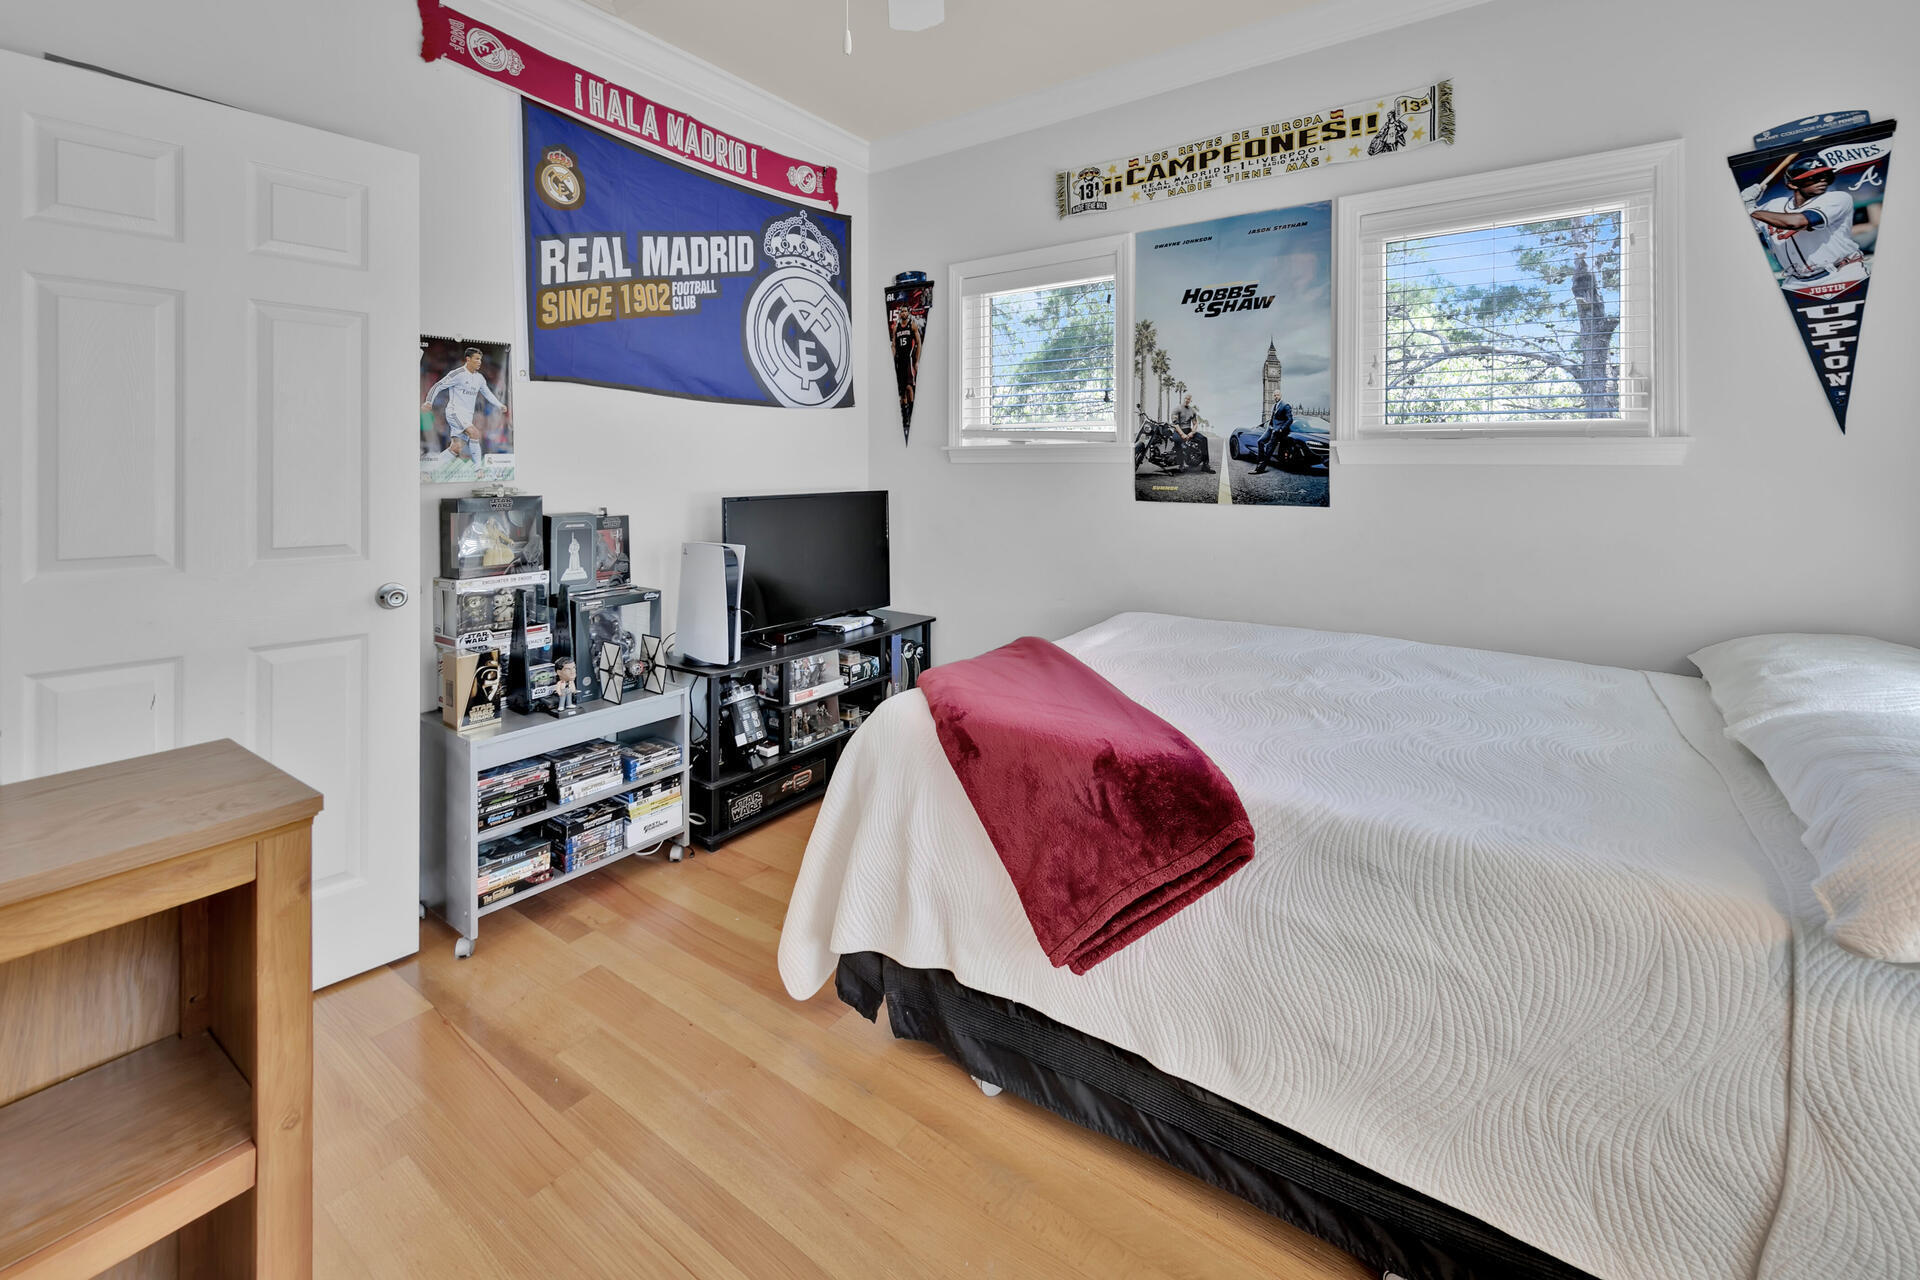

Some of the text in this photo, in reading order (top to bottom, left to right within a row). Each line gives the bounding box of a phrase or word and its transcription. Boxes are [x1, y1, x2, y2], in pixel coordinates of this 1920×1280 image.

[1145, 114, 1323, 163] LOS REYES DE EUROPA
[1825, 143, 1881, 167] BRAVES
[1141, 180, 1169, 190] REAL
[1174, 167, 1221, 182] MADRID
[1248, 145, 1326, 165] LIVERPOOL
[1146, 191, 1156, 200] Y
[1167, 179, 1212, 197] NADIE
[1224, 167, 1272, 183] TIENE
[1248, 221, 1309, 235] JASON STATHAM
[1154, 236, 1213, 250] DWAYNE JOHNSON
[540, 235, 754, 286] REAL MADRID
[672, 279, 717, 296] FOOTBALL
[1181, 284, 1259, 305] HOBBS
[1808, 283, 1846, 295] JUSTIN
[541, 283, 671, 325] SINCE 1902
[672, 295, 697, 311] CLUB
[1194, 295, 1276, 318] & SHAW
[889, 309, 899, 322] 15
[900, 337, 908, 346] 15
[1796, 299, 1865, 387] UPTON
[465, 631, 488, 640] STAR
[465, 636, 488, 645] WARS
[735, 791, 763, 808] STAR
[731, 800, 762, 820] WARS
